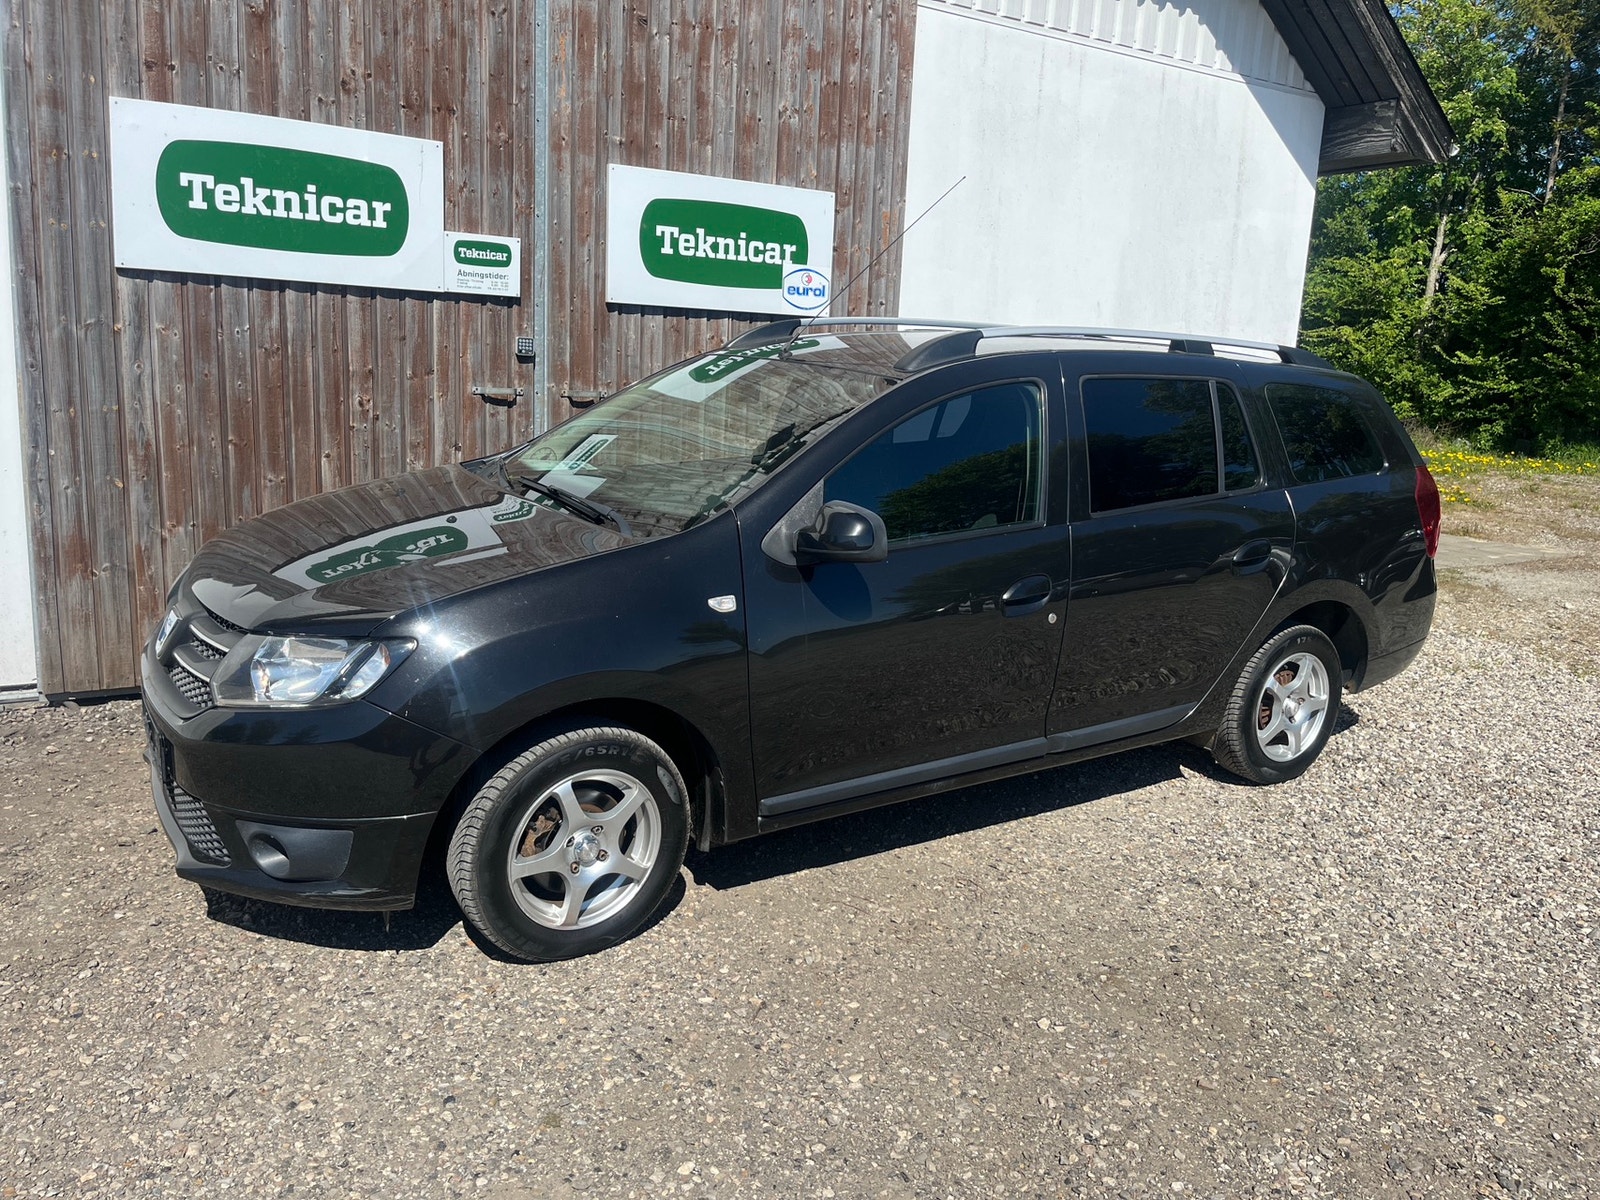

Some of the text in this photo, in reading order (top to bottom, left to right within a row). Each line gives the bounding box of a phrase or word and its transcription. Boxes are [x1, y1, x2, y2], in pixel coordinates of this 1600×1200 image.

[179, 172, 391, 228] Teknicar
[458, 247, 508, 260] Teknicar
[656, 224, 796, 264] Teknicar
[787, 285, 826, 298] eurol
